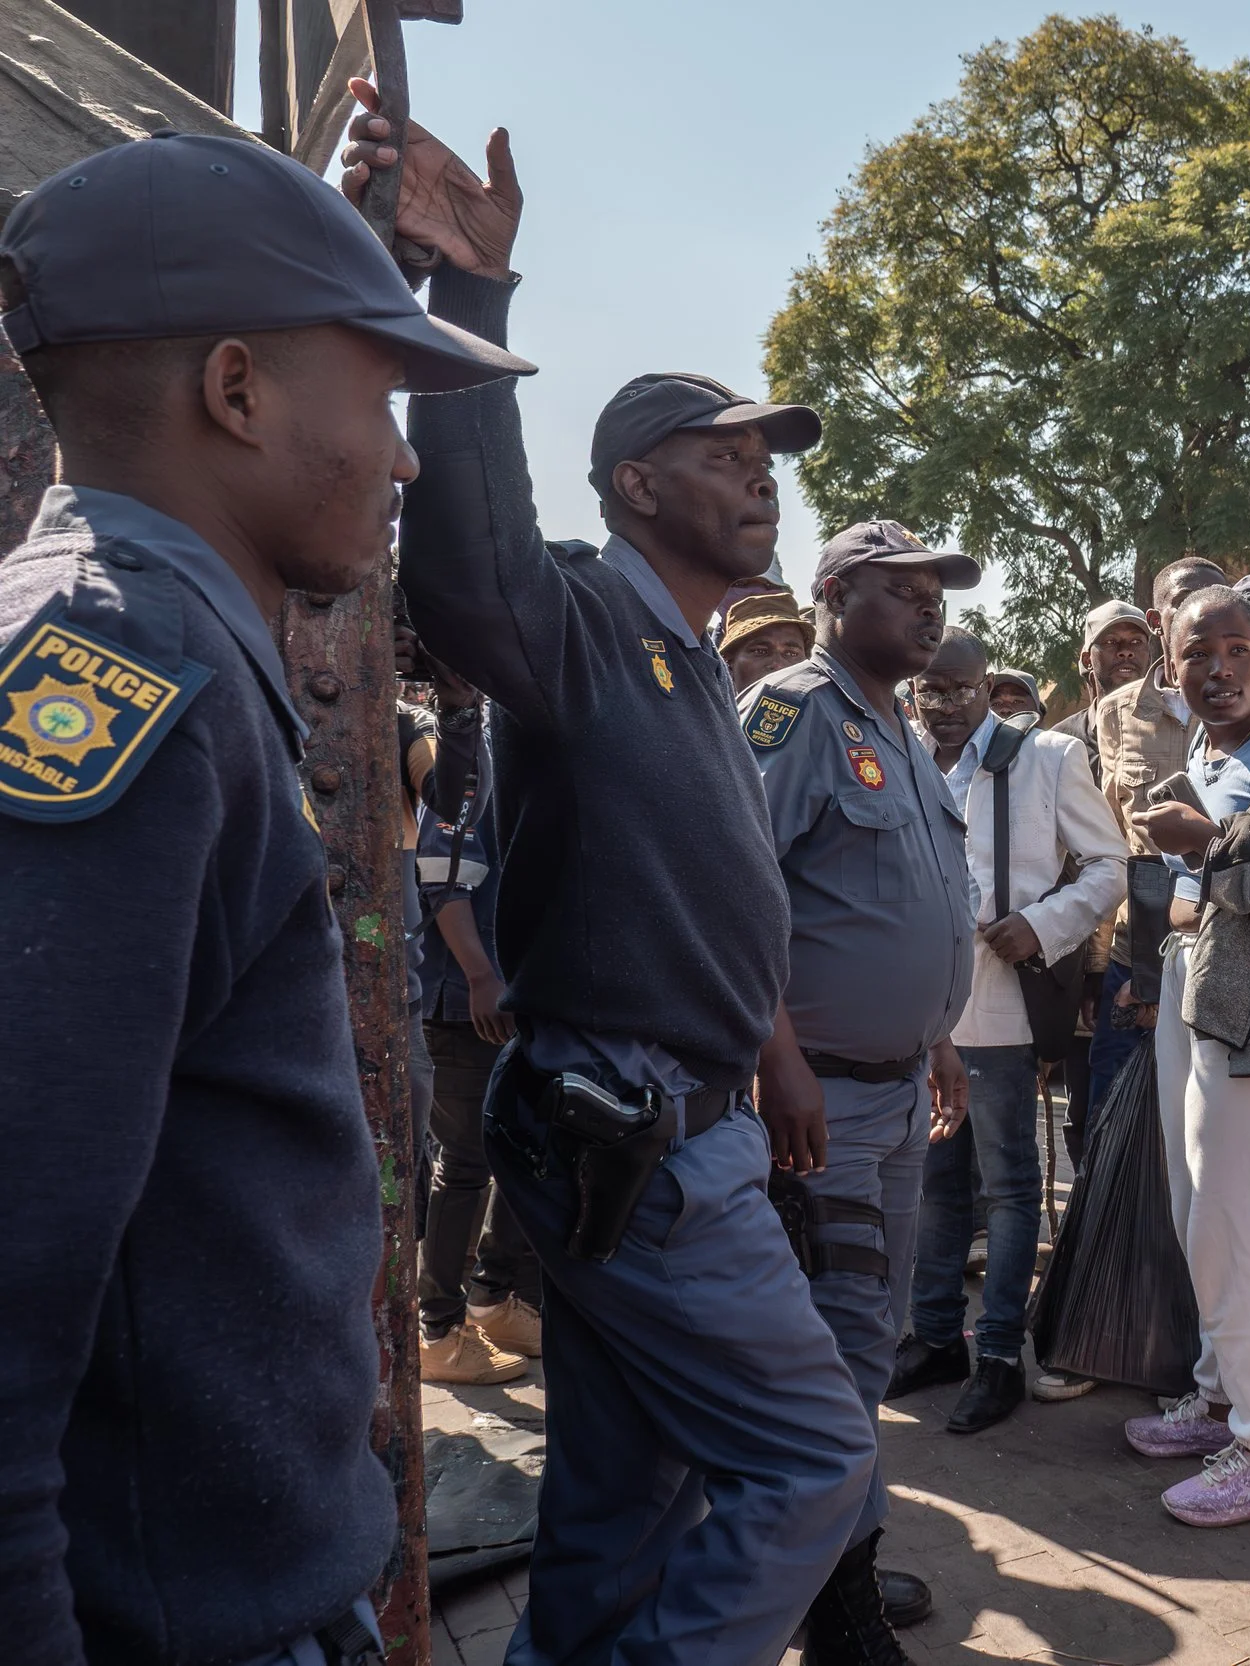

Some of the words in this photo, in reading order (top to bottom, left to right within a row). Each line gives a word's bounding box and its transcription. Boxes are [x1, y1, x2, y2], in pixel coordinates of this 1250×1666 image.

[35, 635, 164, 711] POLICE
[761, 699, 796, 718] POLICE
[0, 742, 79, 793] NSTABLE
